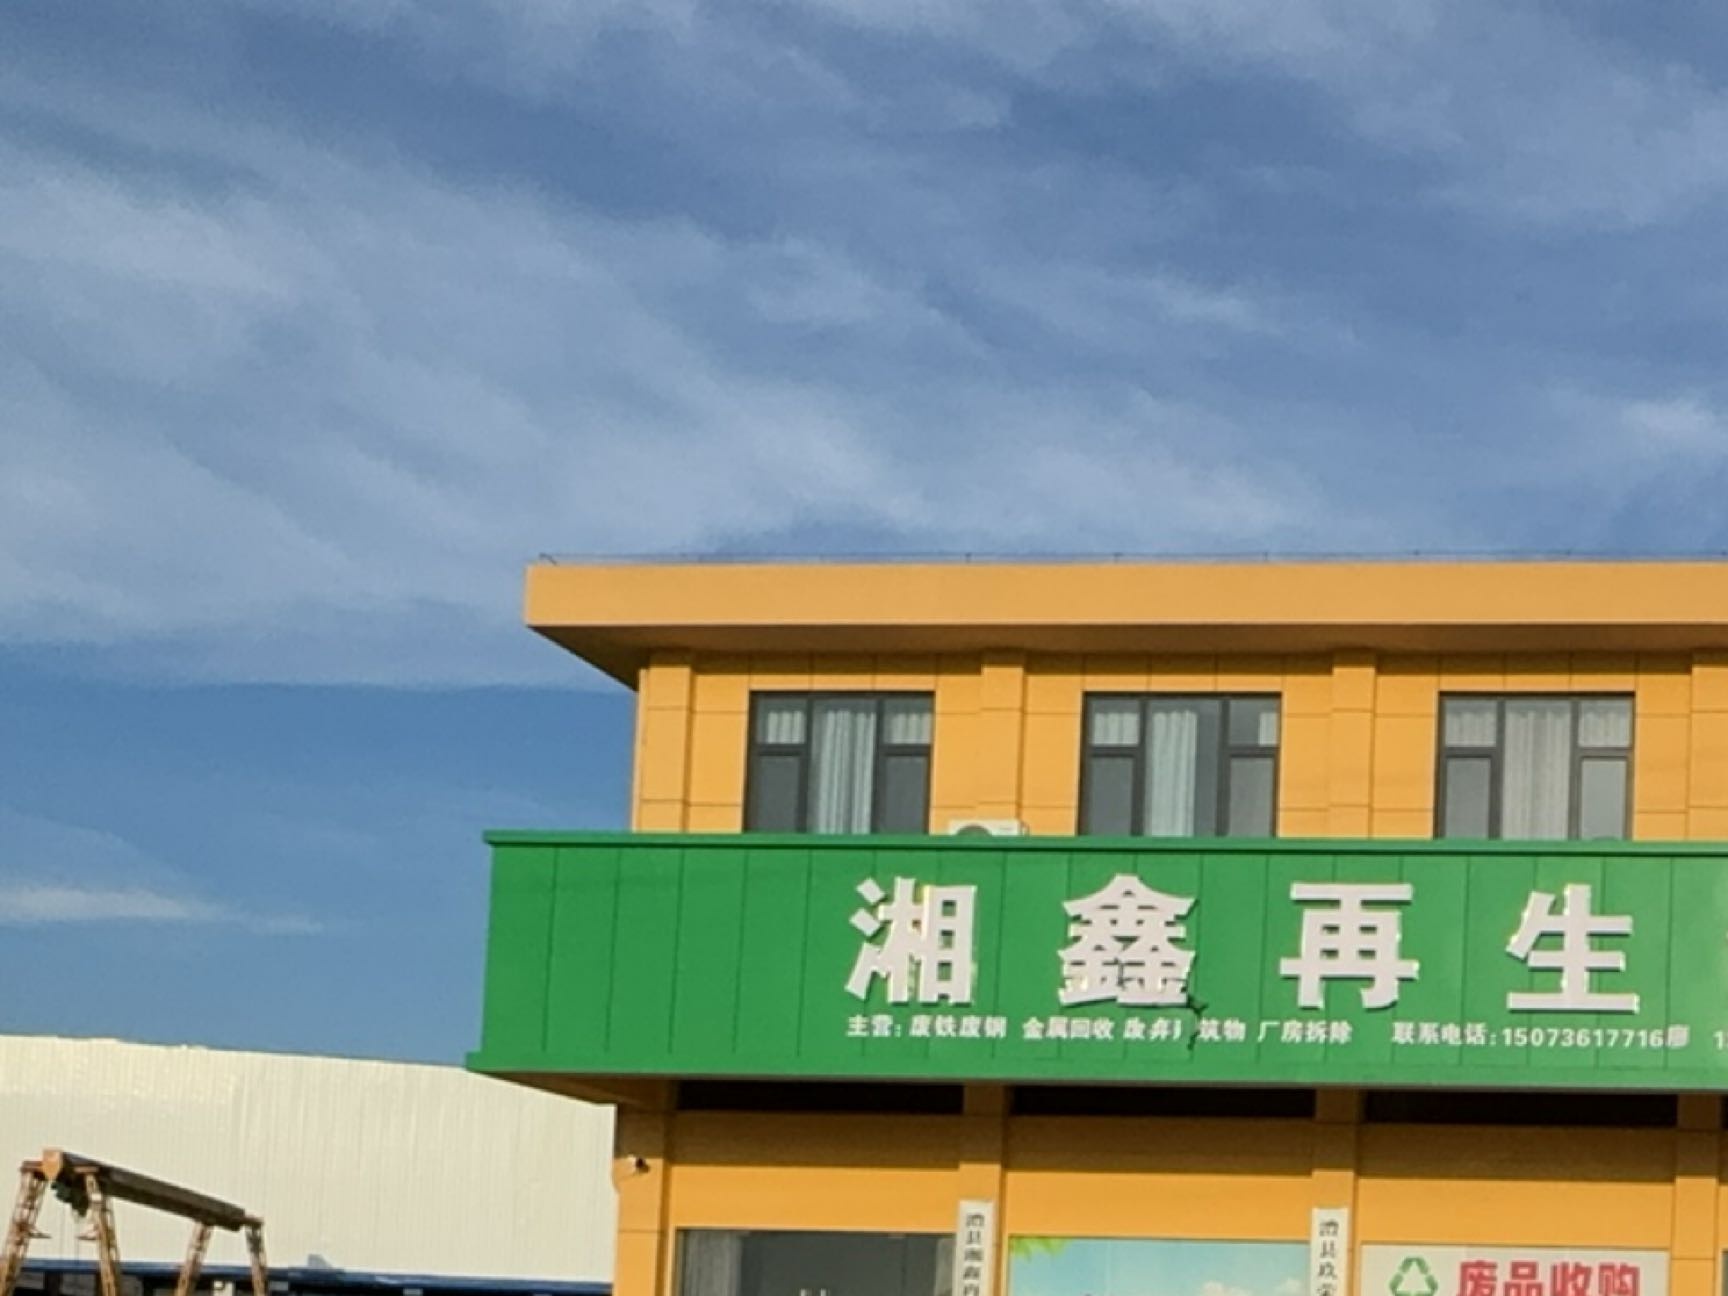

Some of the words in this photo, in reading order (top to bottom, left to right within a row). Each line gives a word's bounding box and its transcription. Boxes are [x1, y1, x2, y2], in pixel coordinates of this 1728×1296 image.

[1022, 1016, 1115, 1040] 金属回收
[1257, 1019, 1353, 1044] 厂房拆除
